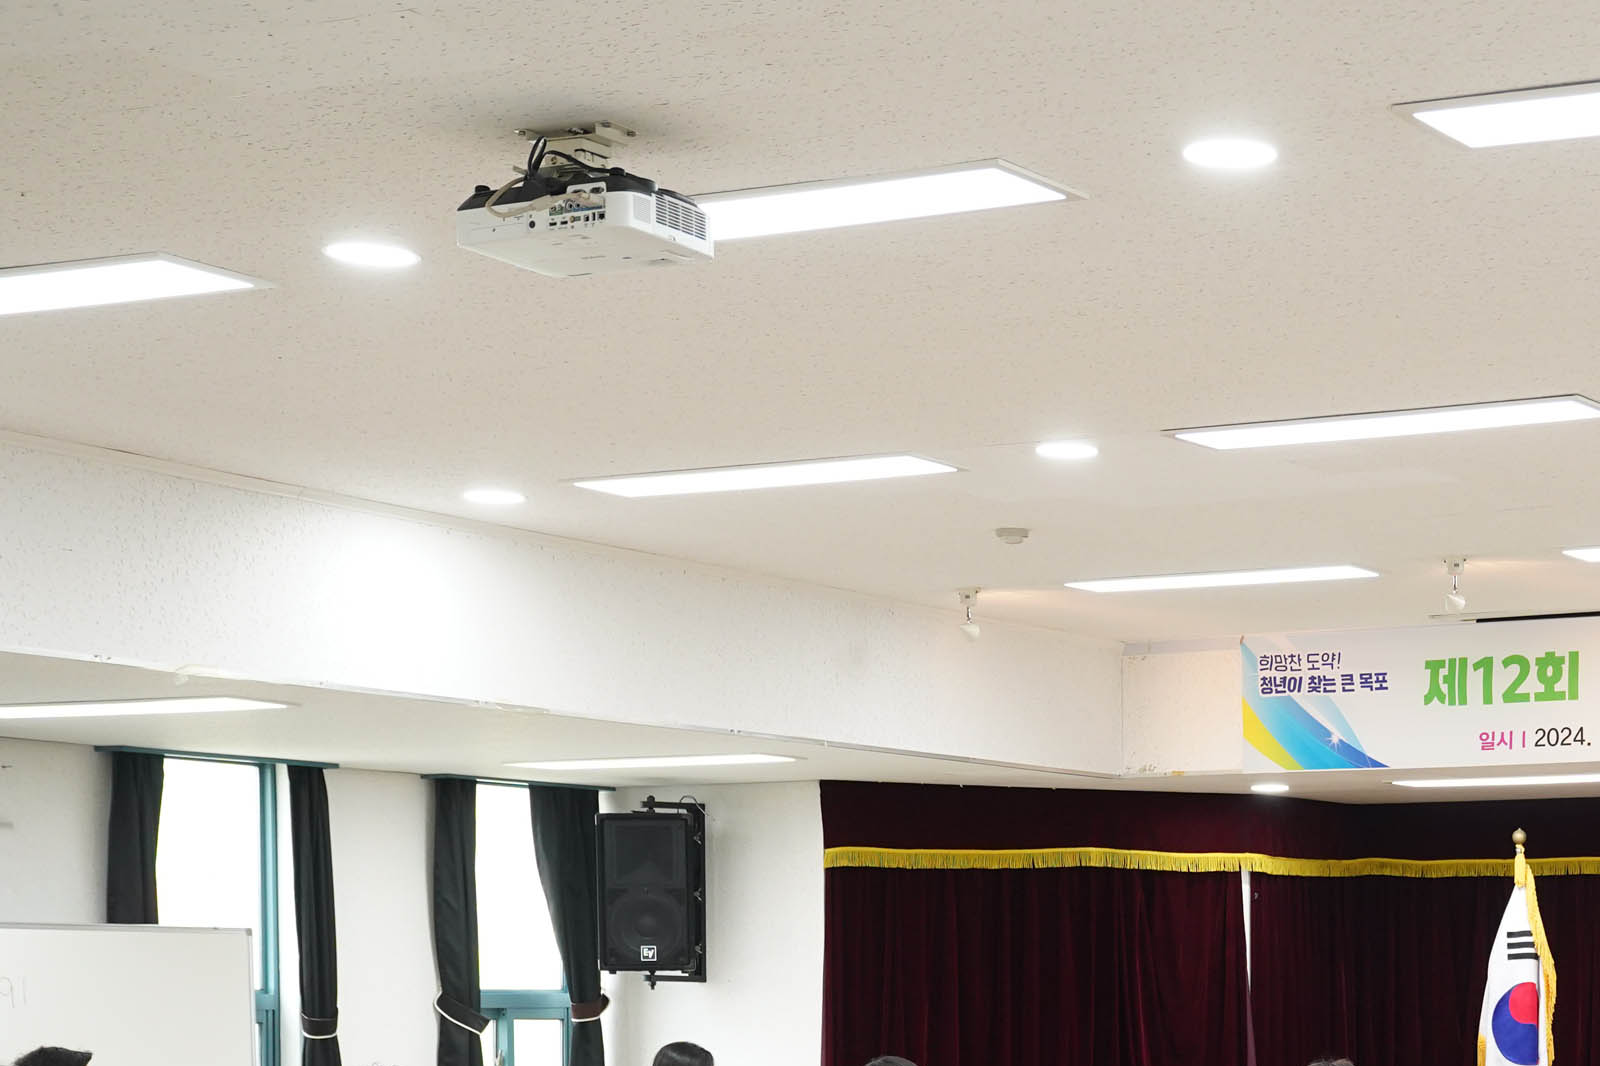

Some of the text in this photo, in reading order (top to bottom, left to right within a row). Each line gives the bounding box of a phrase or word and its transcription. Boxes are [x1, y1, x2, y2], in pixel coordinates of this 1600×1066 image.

[1259, 651, 1341, 672] 희망찬 도약!
[1260, 671, 1389, 695] 청년이 찾는 큰 목포
[1424, 651, 1580, 706] 제12회
[1479, 730, 1513, 751] 일시
[1534, 726, 1592, 748] 2024.
